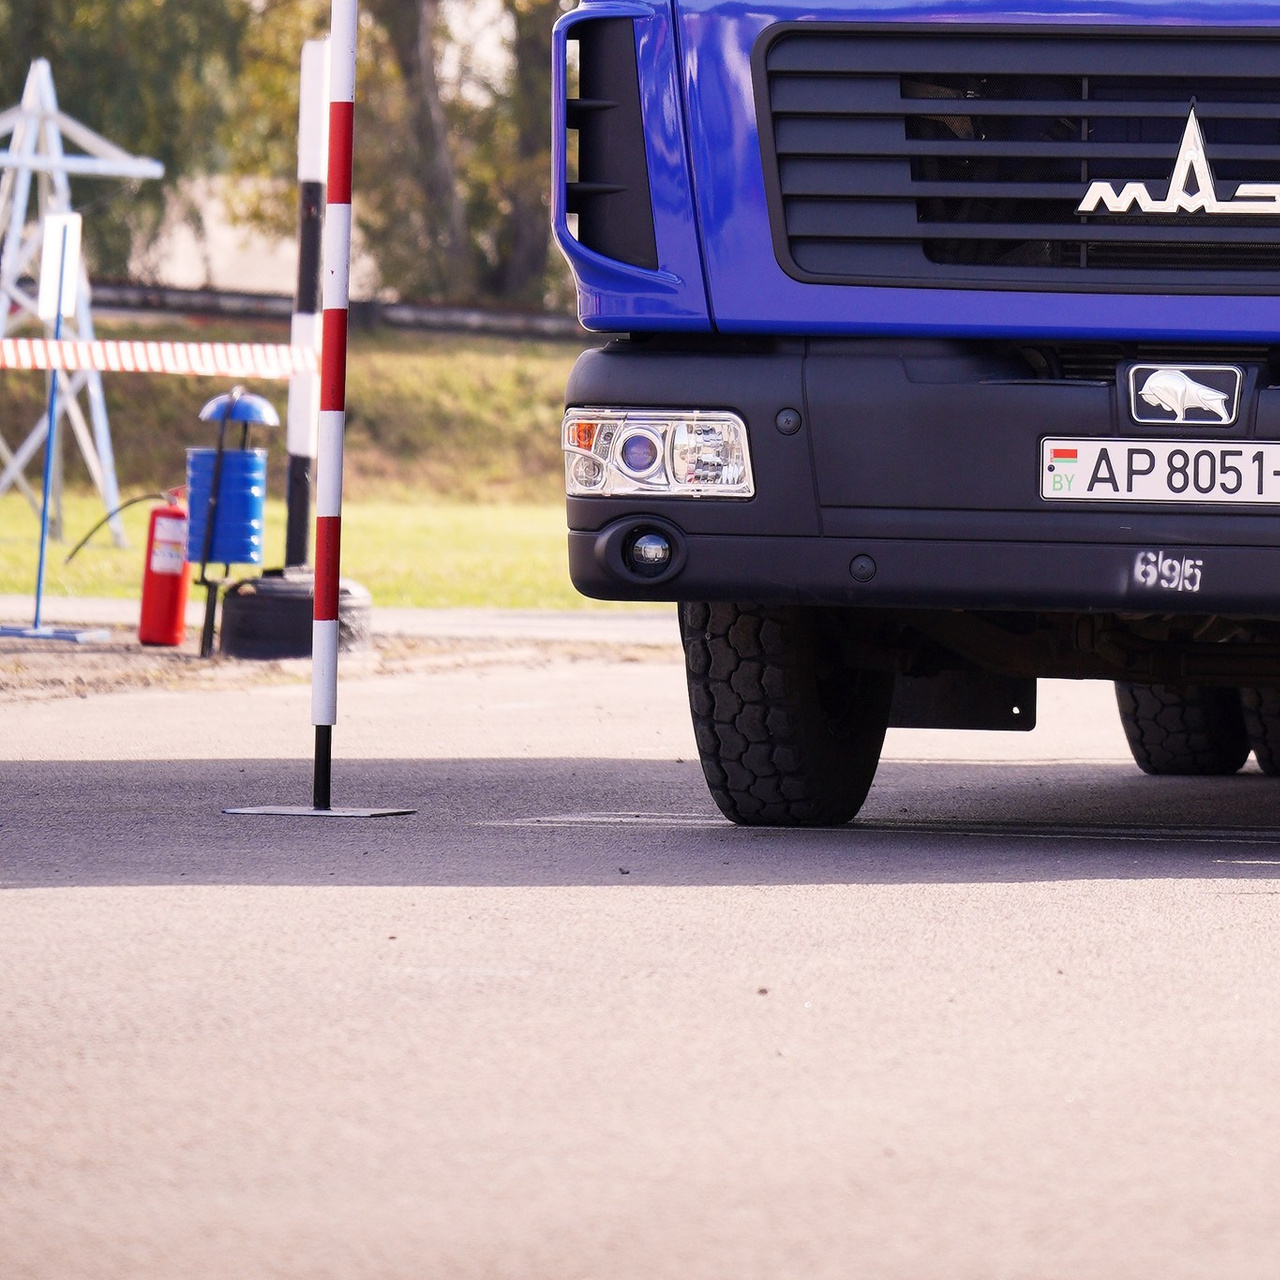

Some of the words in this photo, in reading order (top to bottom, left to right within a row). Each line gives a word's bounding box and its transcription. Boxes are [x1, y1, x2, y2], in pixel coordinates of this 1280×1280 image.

[1052, 473, 1075, 492] BY
[1086, 447, 1156, 493] AP
[1133, 550, 1204, 593] 695
